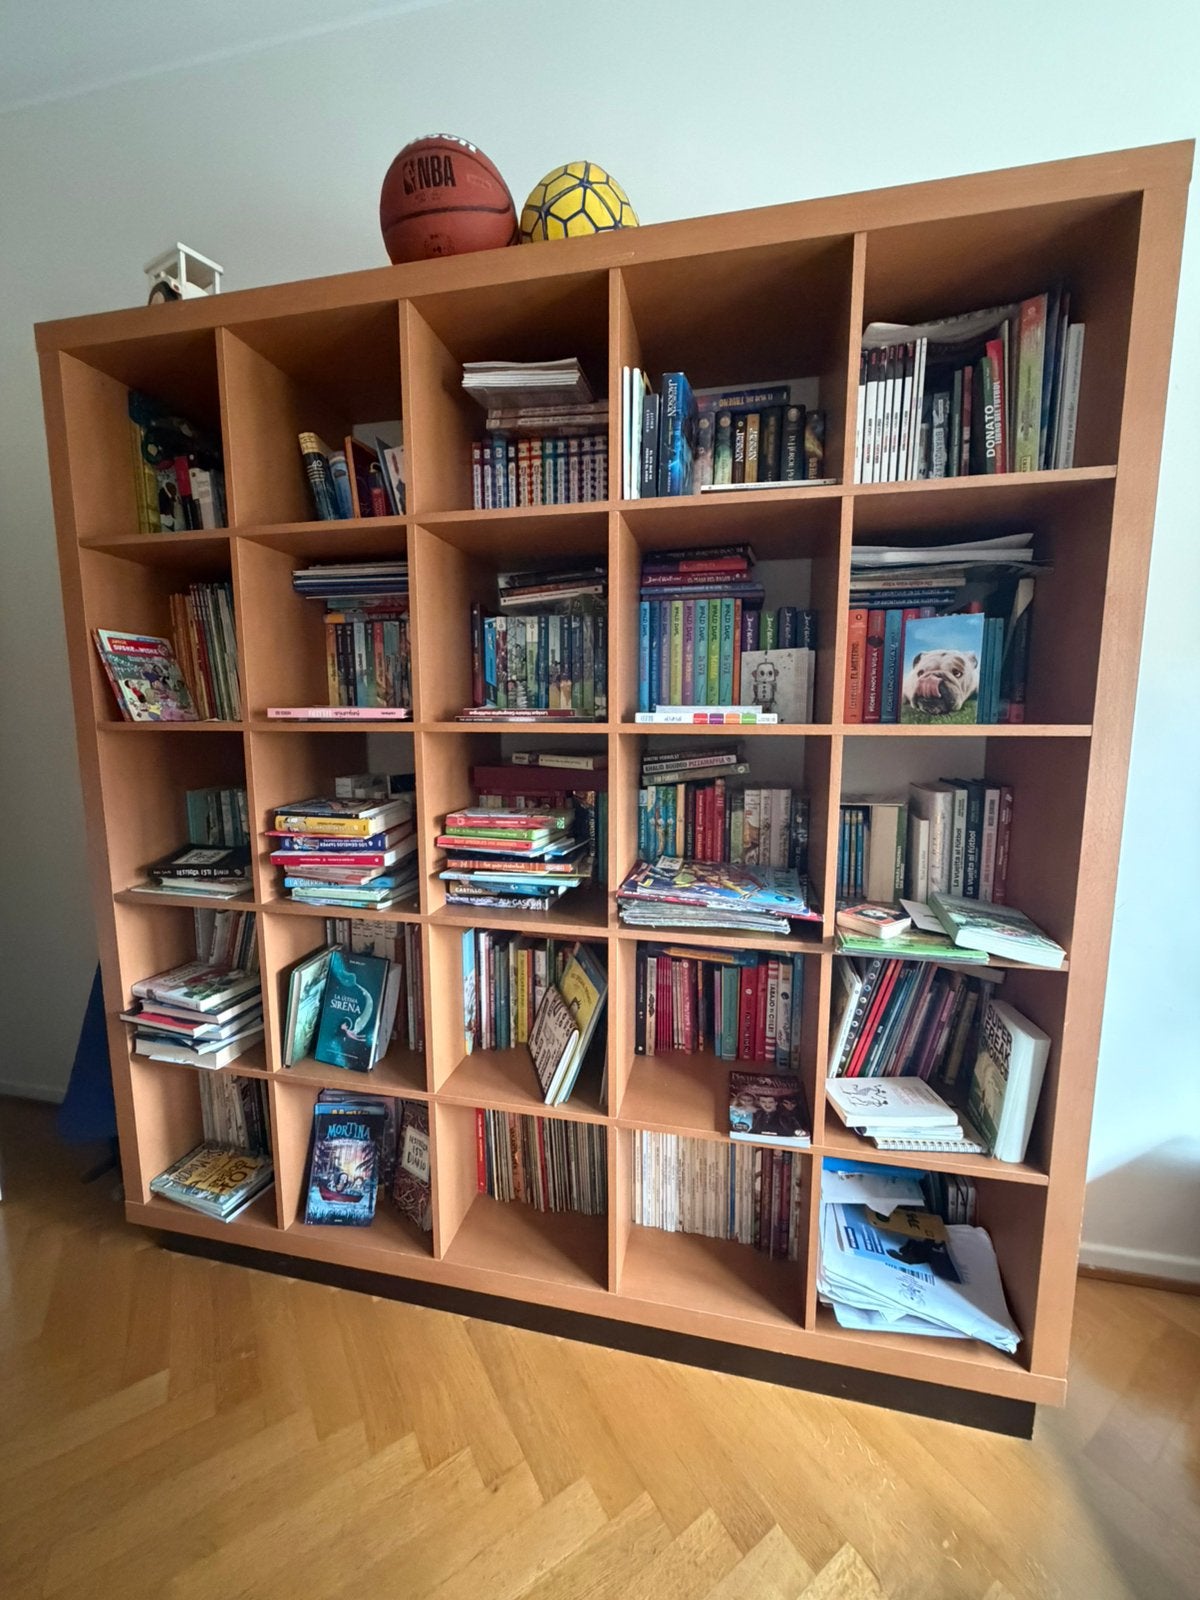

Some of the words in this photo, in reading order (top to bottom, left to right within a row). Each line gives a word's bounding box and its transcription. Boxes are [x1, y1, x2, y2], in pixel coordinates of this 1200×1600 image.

[417, 155, 457, 189] NBA
[984, 405, 996, 458] DONATO
[954, 828, 962, 849] fútbol
[967, 830, 976, 854] fútbol
[954, 848, 960, 856] al
[967, 854, 975, 862] al
[953, 856, 961, 879] vuelta
[966, 862, 974, 885] vuelta
[455, 886, 482, 894] CASTILLO
[953, 879, 960, 888] La
[966, 886, 974, 895] La
[330, 999, 361, 1014] SIRENA
[987, 1005, 1013, 1052] SUPER
[326, 1121, 371, 1140] MORTINA
